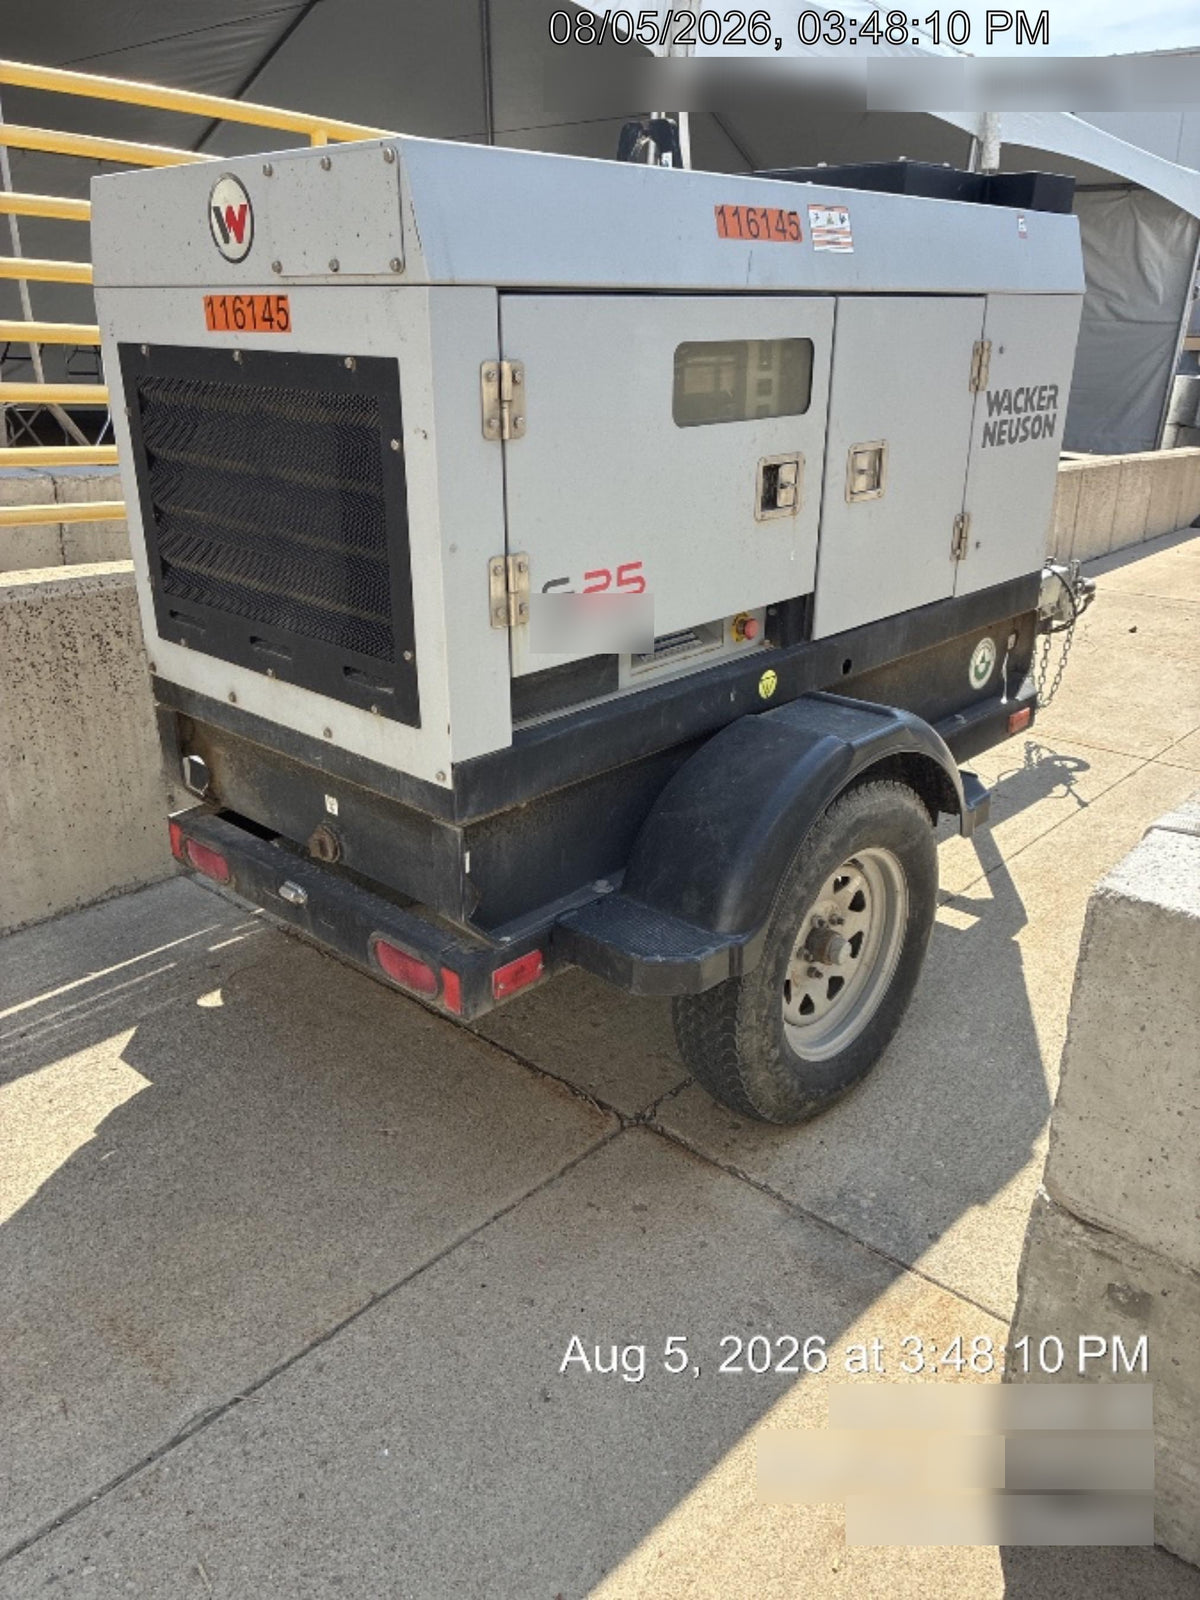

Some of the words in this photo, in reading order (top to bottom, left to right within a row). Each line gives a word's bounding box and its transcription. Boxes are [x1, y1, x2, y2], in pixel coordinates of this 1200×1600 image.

[717, 204, 801, 241] 116145
[206, 295, 290, 331] 116145
[986, 384, 1059, 418] WACKER
[981, 413, 1057, 449] NEUSON
